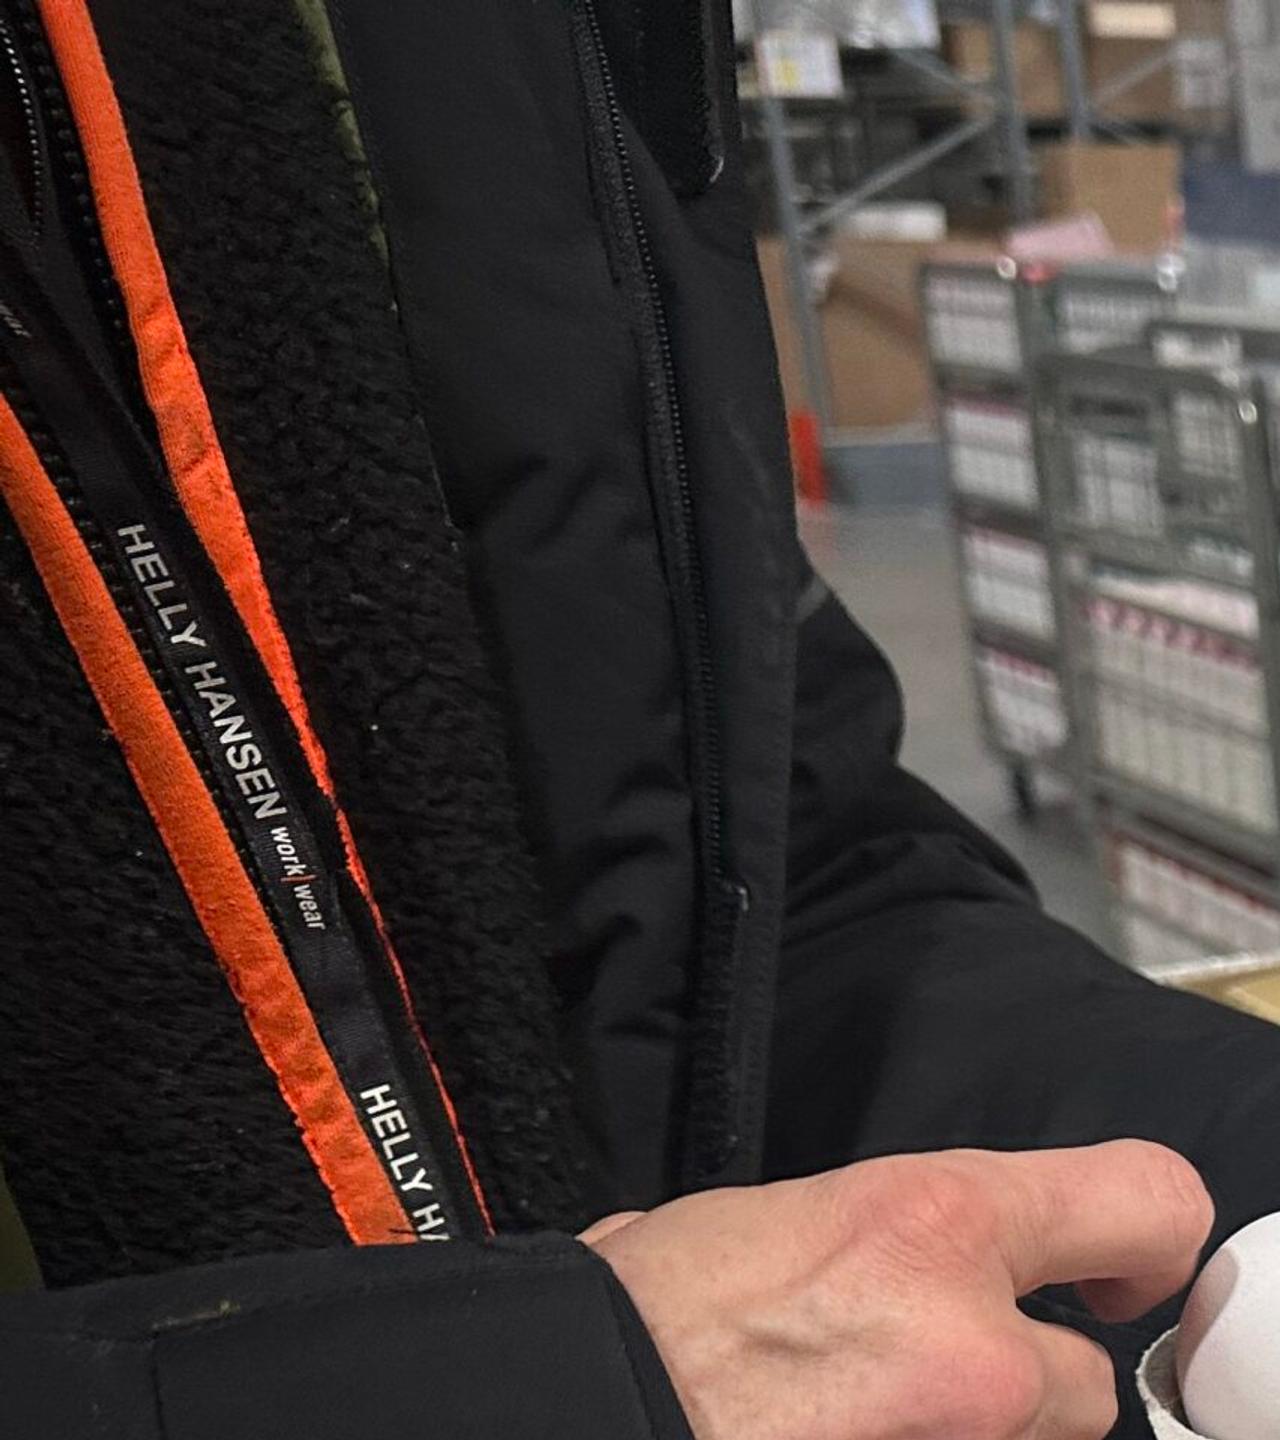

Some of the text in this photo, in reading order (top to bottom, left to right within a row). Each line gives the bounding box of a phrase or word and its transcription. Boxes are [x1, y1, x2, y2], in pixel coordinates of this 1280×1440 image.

[116, 523, 206, 648] HELLY
[185, 661, 287, 821] HANSEN
[360, 1083, 432, 1193] HELLY
